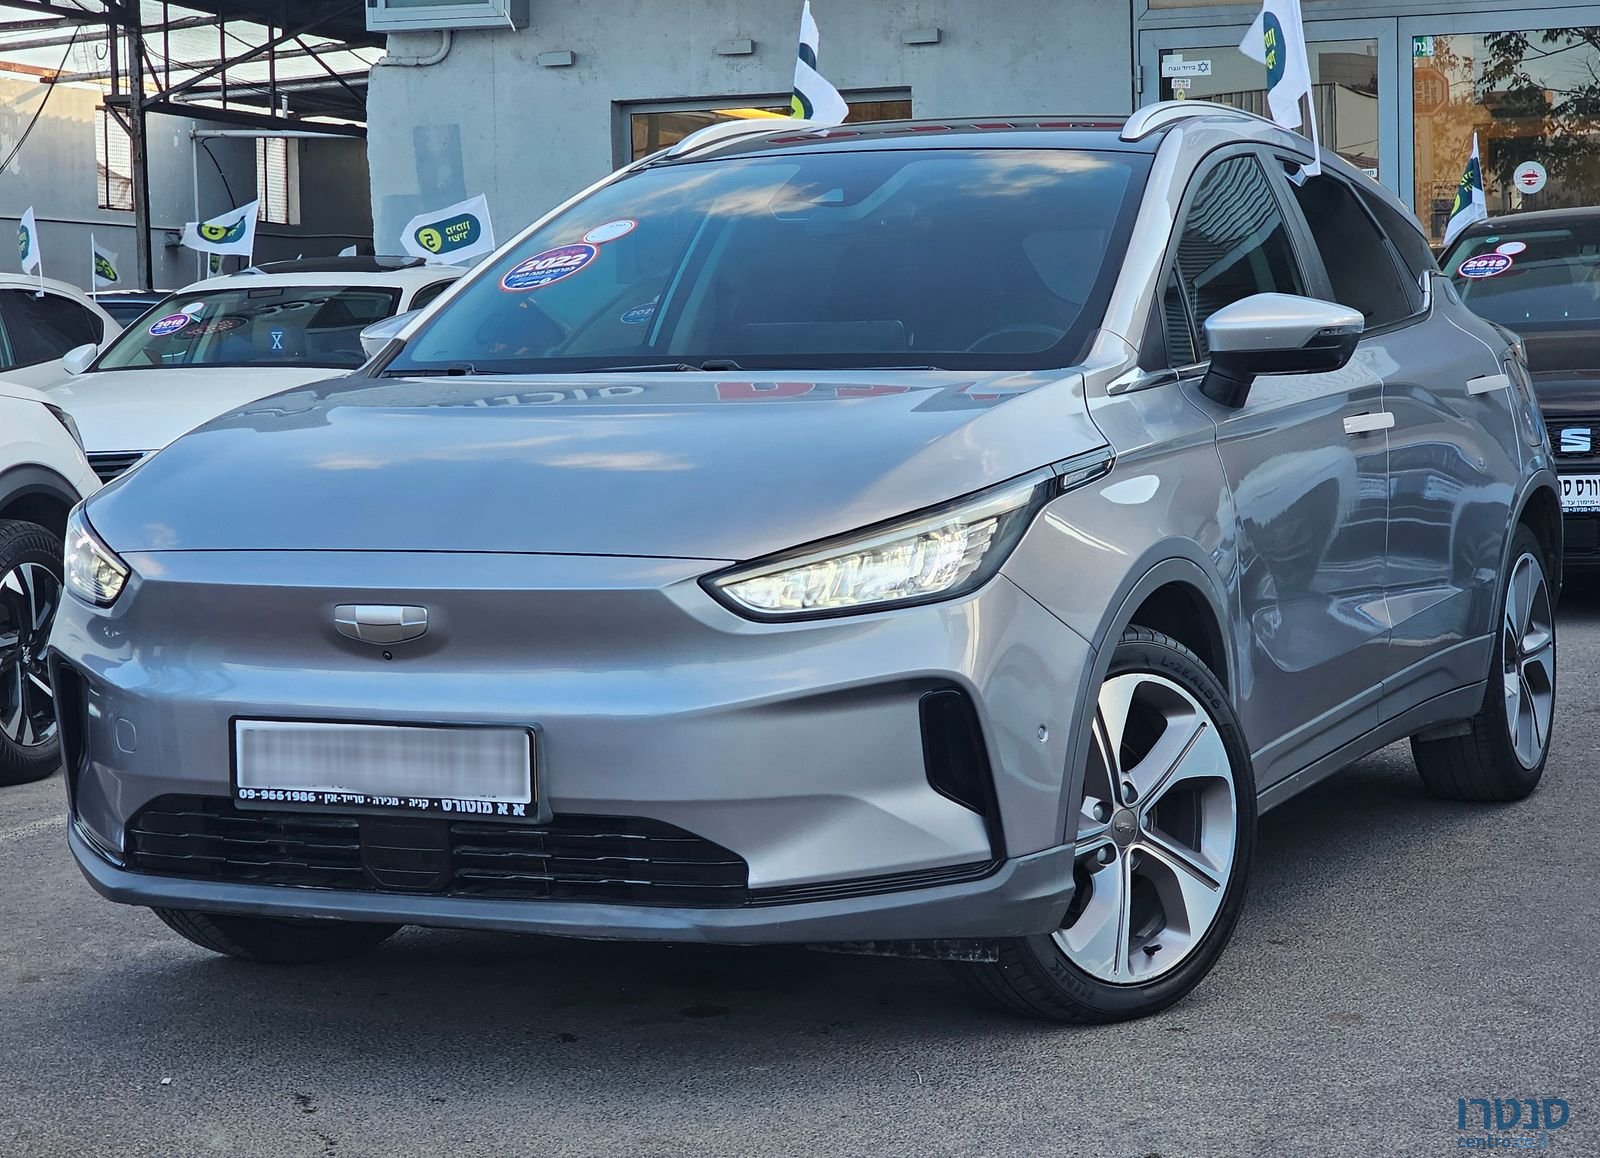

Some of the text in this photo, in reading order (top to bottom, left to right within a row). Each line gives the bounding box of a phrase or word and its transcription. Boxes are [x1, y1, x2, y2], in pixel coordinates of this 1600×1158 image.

[516, 253, 588, 273] 2022
[1465, 259, 1507, 268] 2019
[324, 793, 365, 805] טרייד-אין
[372, 795, 400, 807] מכירה
[408, 797, 429, 810] קניה
[441, 799, 493, 815] מוטורס
[497, 803, 509, 815] א
[512, 803, 526, 817] א
